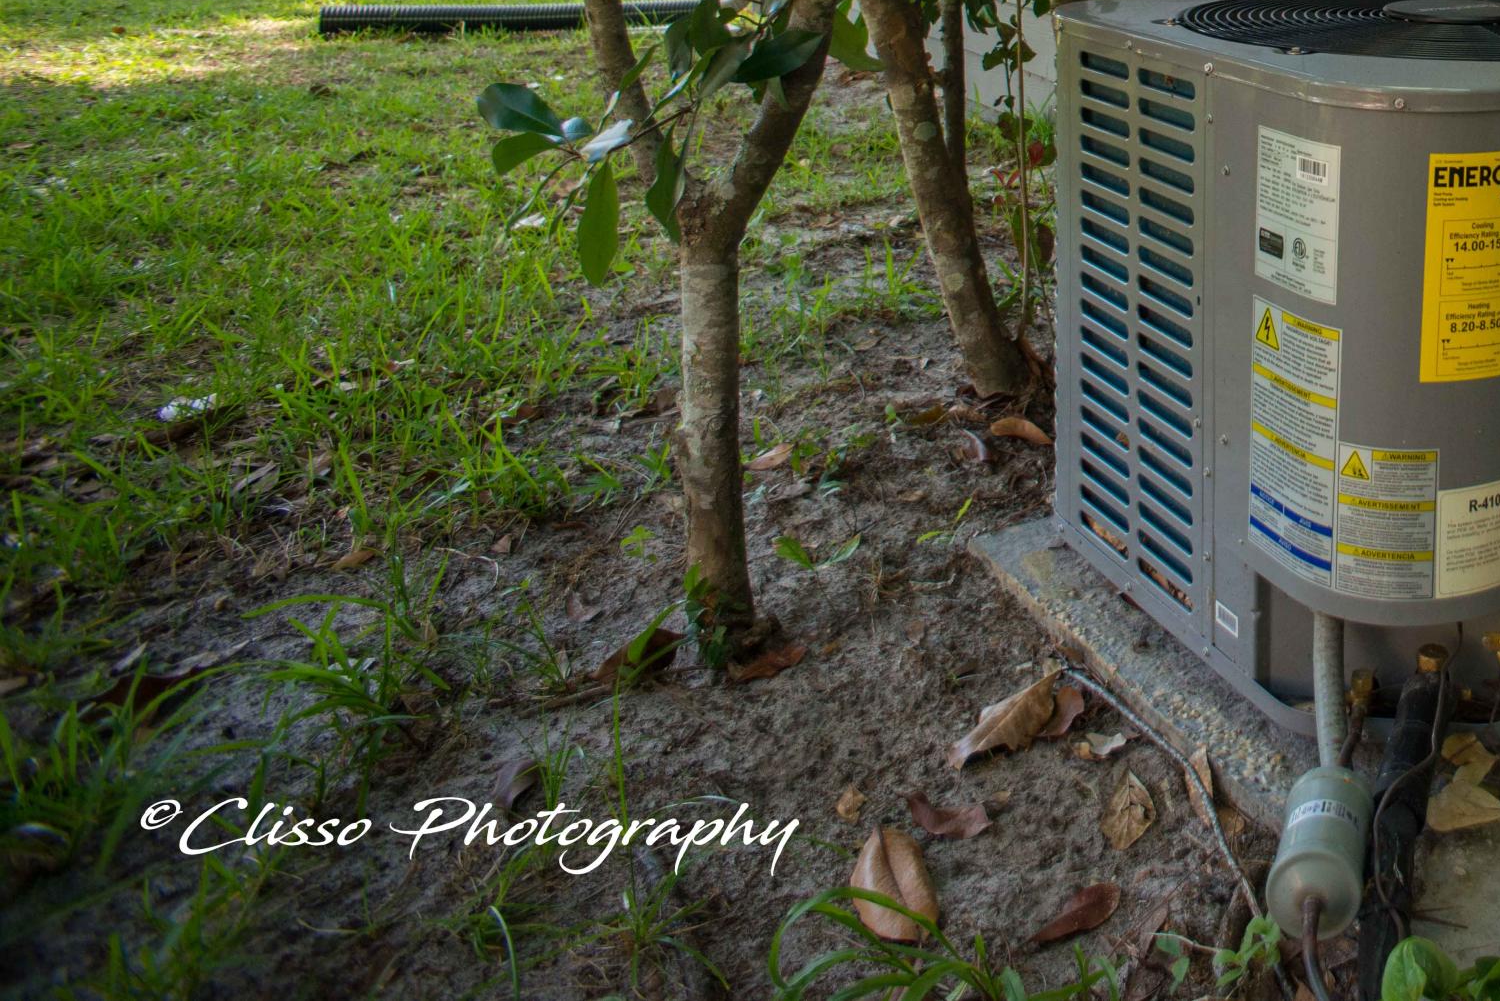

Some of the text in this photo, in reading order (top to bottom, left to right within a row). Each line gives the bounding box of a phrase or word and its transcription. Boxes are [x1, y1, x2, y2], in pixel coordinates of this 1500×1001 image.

[1471, 222, 1494, 230] Cooling
[1449, 232, 1479, 240] Efficiency
[1481, 230, 1500, 239] Rating
[1467, 302, 1490, 310] Heating
[1445, 312, 1476, 321] Efficiency
[1477, 310, 1496, 318] Rating
[1358, 499, 1421, 510] AVERTISSEMENT
[1360, 549, 1415, 560] ADVERTENCIA
